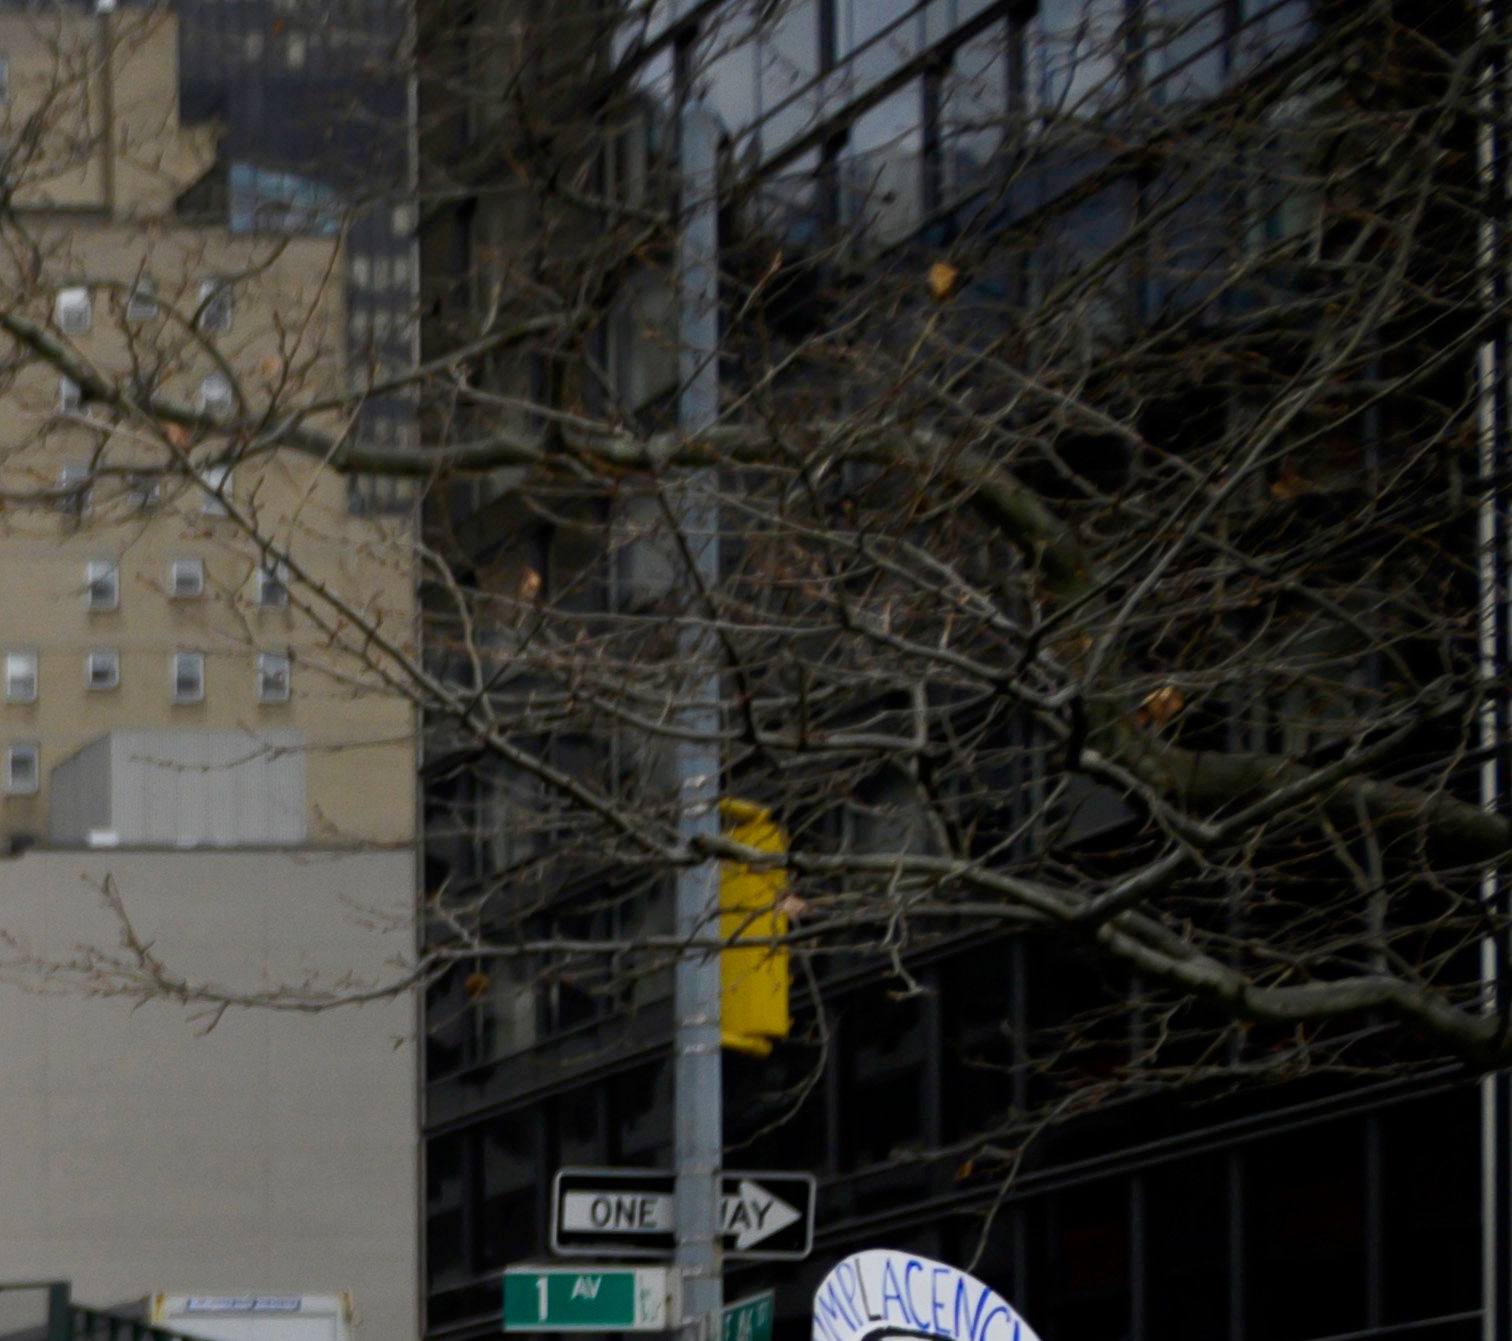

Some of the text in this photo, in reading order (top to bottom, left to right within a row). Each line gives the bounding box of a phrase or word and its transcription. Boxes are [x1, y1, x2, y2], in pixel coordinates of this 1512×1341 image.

[590, 1196, 774, 1231] ONE AY
[535, 1275, 603, 1322] 1 AV
